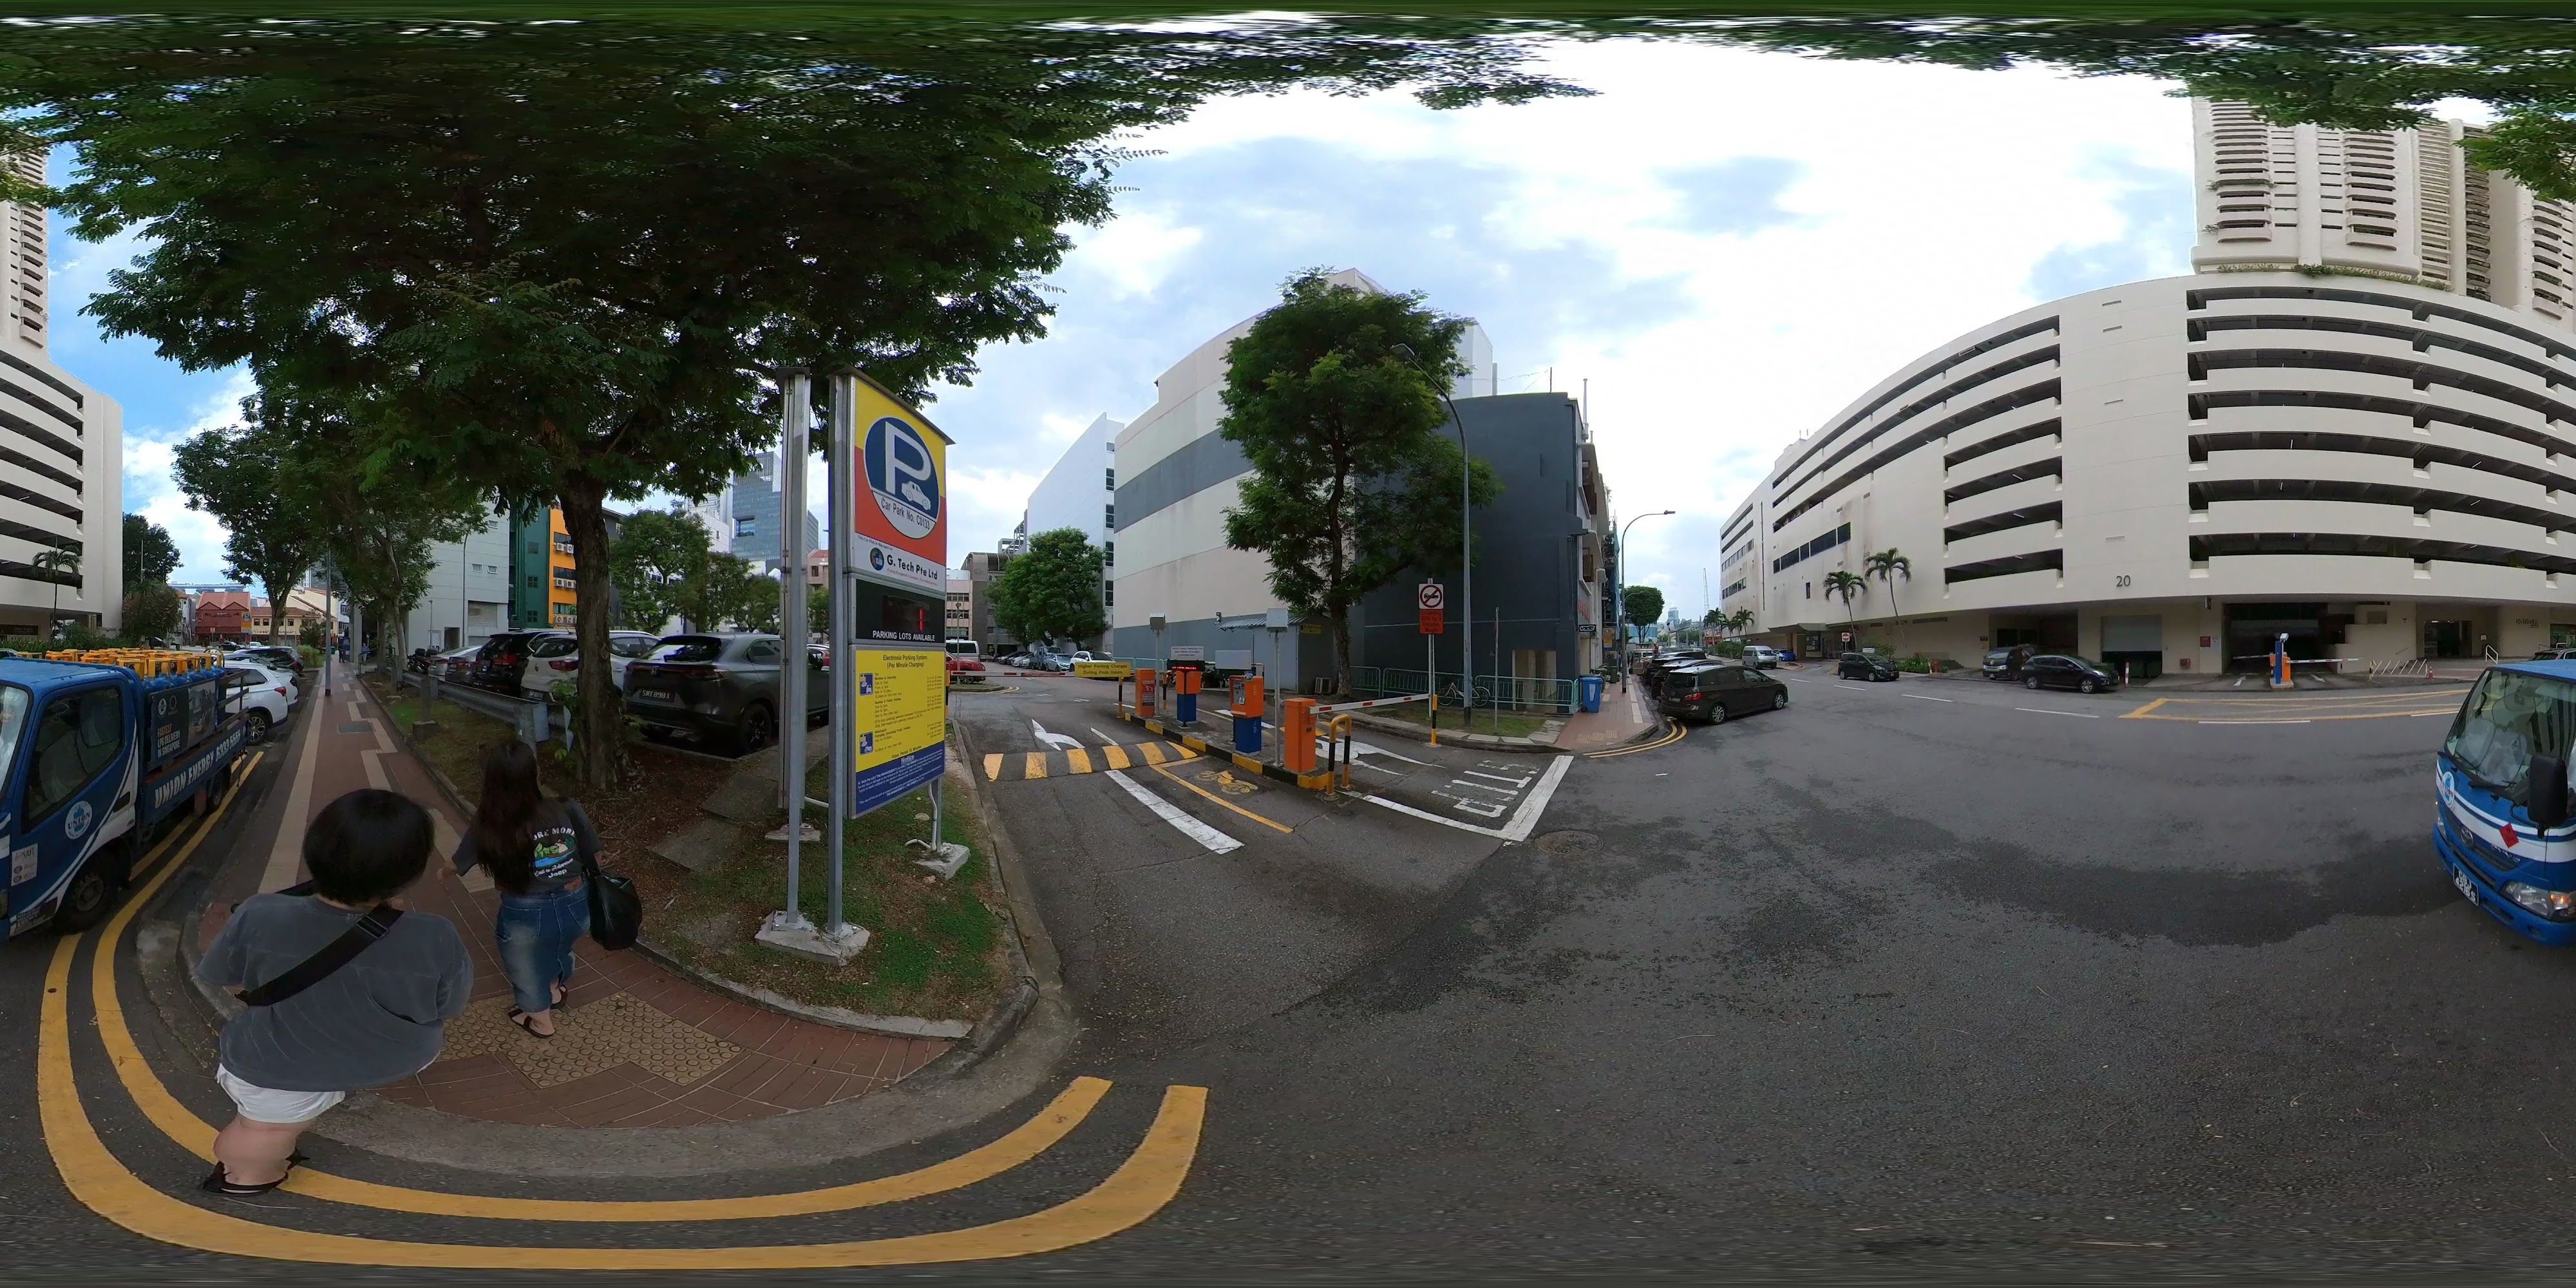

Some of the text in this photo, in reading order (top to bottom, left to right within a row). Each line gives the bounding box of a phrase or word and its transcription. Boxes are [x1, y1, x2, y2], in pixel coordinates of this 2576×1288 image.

[885, 421, 931, 495] P
[881, 497, 891, 511] Car
[893, 504, 905, 517] Park
[916, 515, 930, 530] C0133
[887, 554, 896, 567] G.
[898, 558, 914, 573] Tech
[916, 565, 927, 576] Pte
[929, 567, 938, 580] Ltd
[2116, 575, 2131, 587] 20
[919, 608, 923, 630] 1
[873, 630, 897, 639] PARKING
[913, 633, 935, 641] AVAILABLE
[158, 723, 173, 738] FASTEST
[164, 730, 180, 745] DELIVERY
[162, 739, 180, 756] SINGAPORE
[901, 755, 914, 764] Notice
[155, 771, 187, 809] UNION
[187, 750, 214, 785] ENERGY
[68, 811, 90, 829] UNION
[548, 869, 568, 878] Jeep
[2458, 870, 2472, 889] GBJ
[2455, 878, 2476, 902] 4216S
